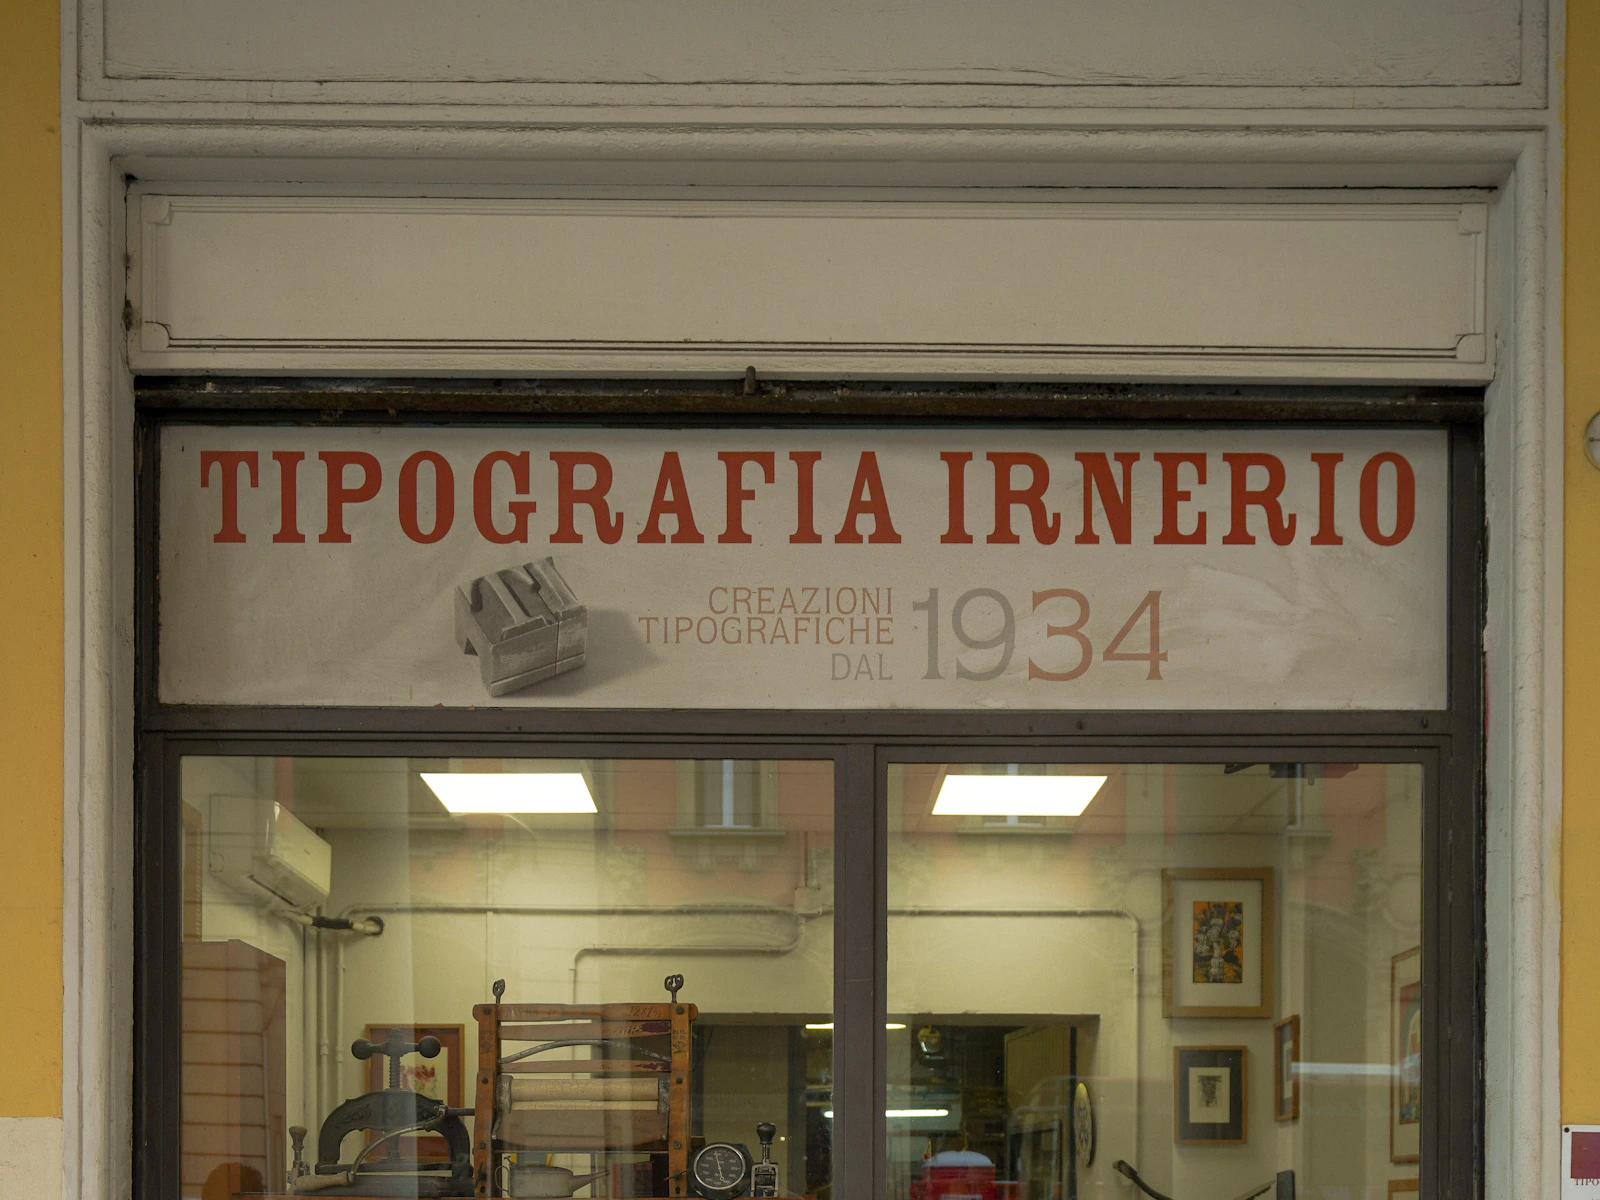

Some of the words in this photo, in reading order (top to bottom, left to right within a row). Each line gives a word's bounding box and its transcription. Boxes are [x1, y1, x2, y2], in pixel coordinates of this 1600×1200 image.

[201, 450, 901, 545] TIPOGRAFIA
[940, 451, 1416, 546] IRNERIO
[637, 616, 894, 645] TIPOGRAFICHE
[708, 586, 894, 615] CREAZIONI
[830, 653, 894, 681] DAL
[912, 587, 1169, 682] 1934
